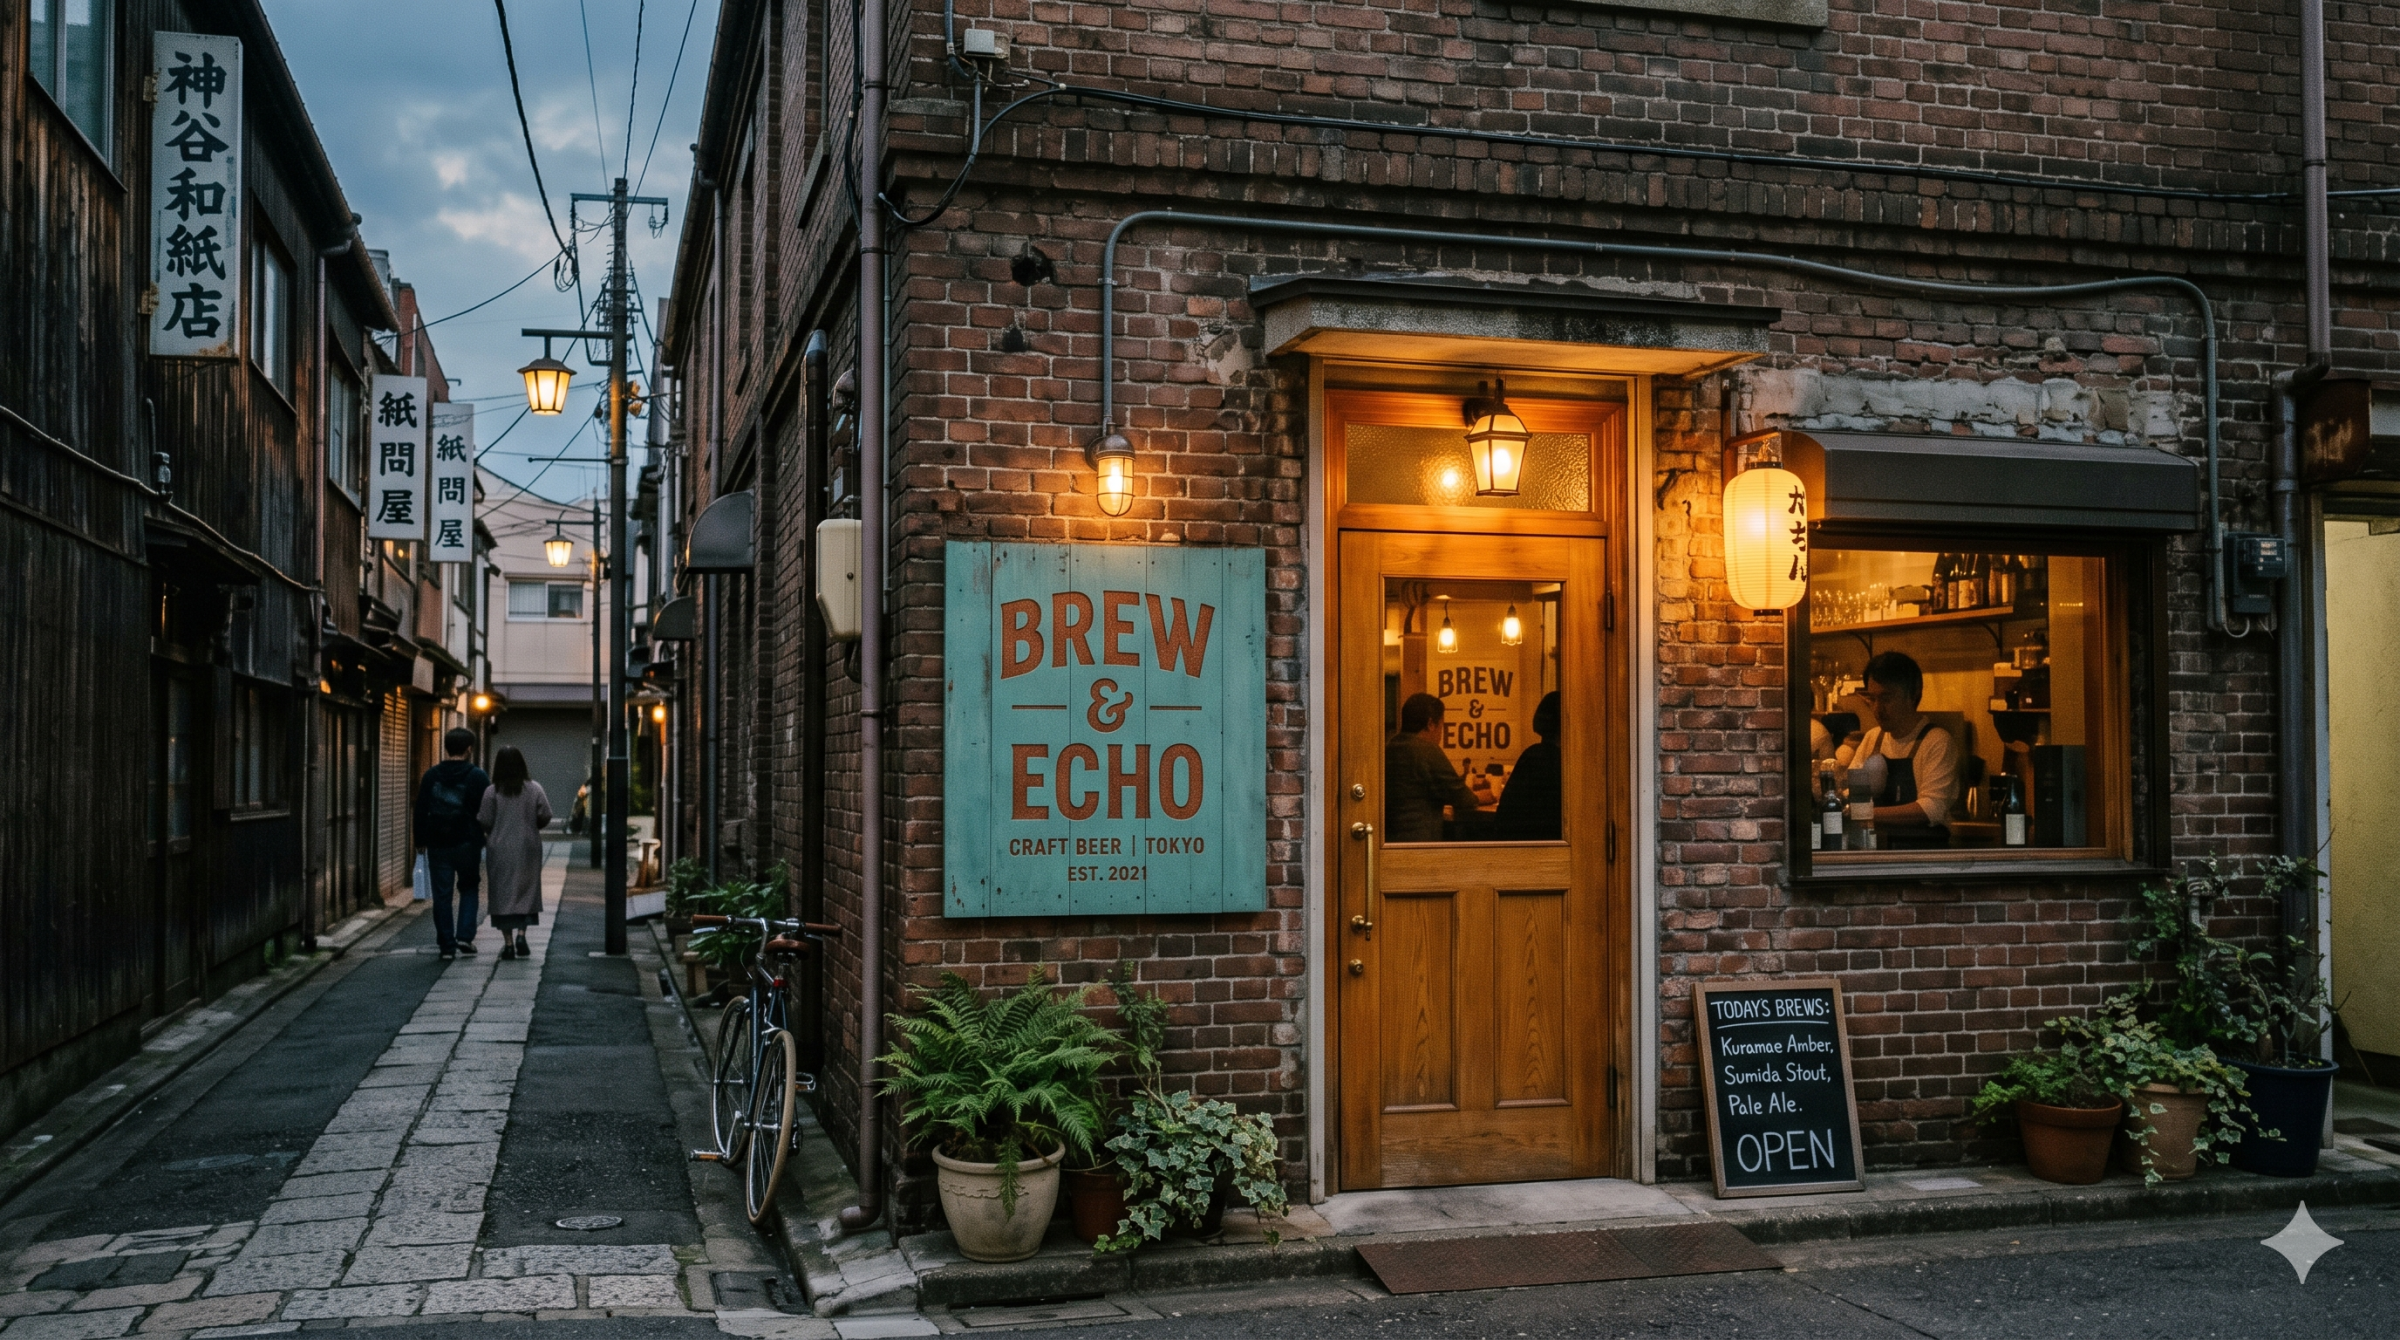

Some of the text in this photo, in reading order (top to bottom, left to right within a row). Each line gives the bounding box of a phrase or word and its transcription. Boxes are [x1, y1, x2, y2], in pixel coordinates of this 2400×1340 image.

[162, 51, 229, 339] 神谷和紙店
[376, 391, 417, 525] 紙問屋
[435, 434, 467, 548] 紙問屋
[1000, 589, 1215, 680] BREW
[1438, 666, 1514, 699] BREW
[1086, 677, 1134, 733] &
[1468, 698, 1485, 719] &
[1442, 721, 1511, 749] ECHO
[1011, 742, 1204, 822] ECHO
[1009, 836, 1205, 857] CRAFT BEER TOKYO
[1068, 865, 1147, 882] EST. 2021
[1710, 998, 1830, 1020] TODAY'S BREWS:
[1720, 1034, 1834, 1056] Kuramae Amber,
[1724, 1062, 1831, 1085] Sumida Stout,
[1728, 1091, 1803, 1116] Pale Ale.
[1737, 1128, 1835, 1173] OPEN
